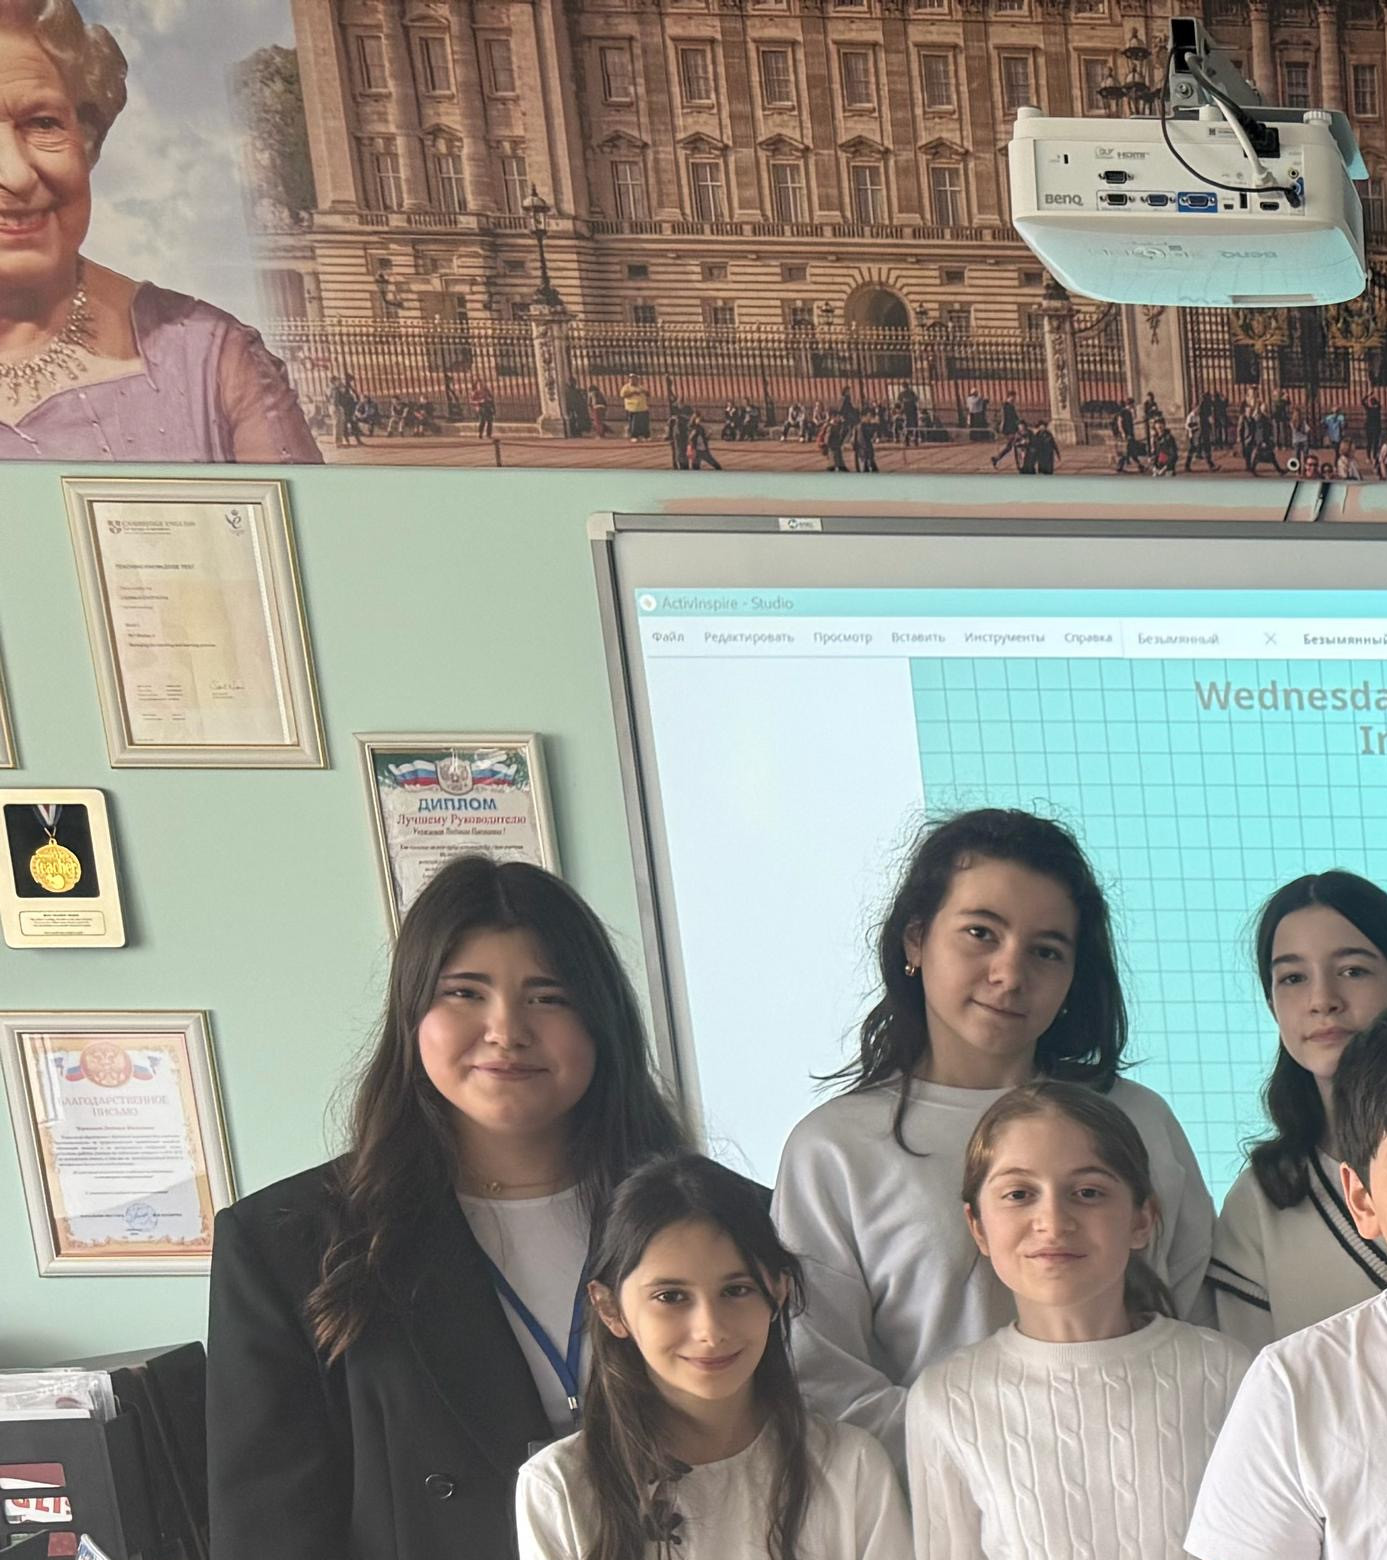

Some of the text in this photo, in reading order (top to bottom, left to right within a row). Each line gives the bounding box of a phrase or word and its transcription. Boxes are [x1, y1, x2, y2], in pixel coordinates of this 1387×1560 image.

[1045, 193, 1083, 206] BenQ
[662, 596, 738, 612] ActivInspire
[751, 596, 794, 611] Studio
[652, 631, 1113, 646] Файл Редактировать Просмотр Вставить Инструменты Справка
[1138, 632, 1220, 645] Безымянный
[418, 797, 497, 813] ДИПЛОМ
[397, 813, 526, 827] Лучшему Руководителю
